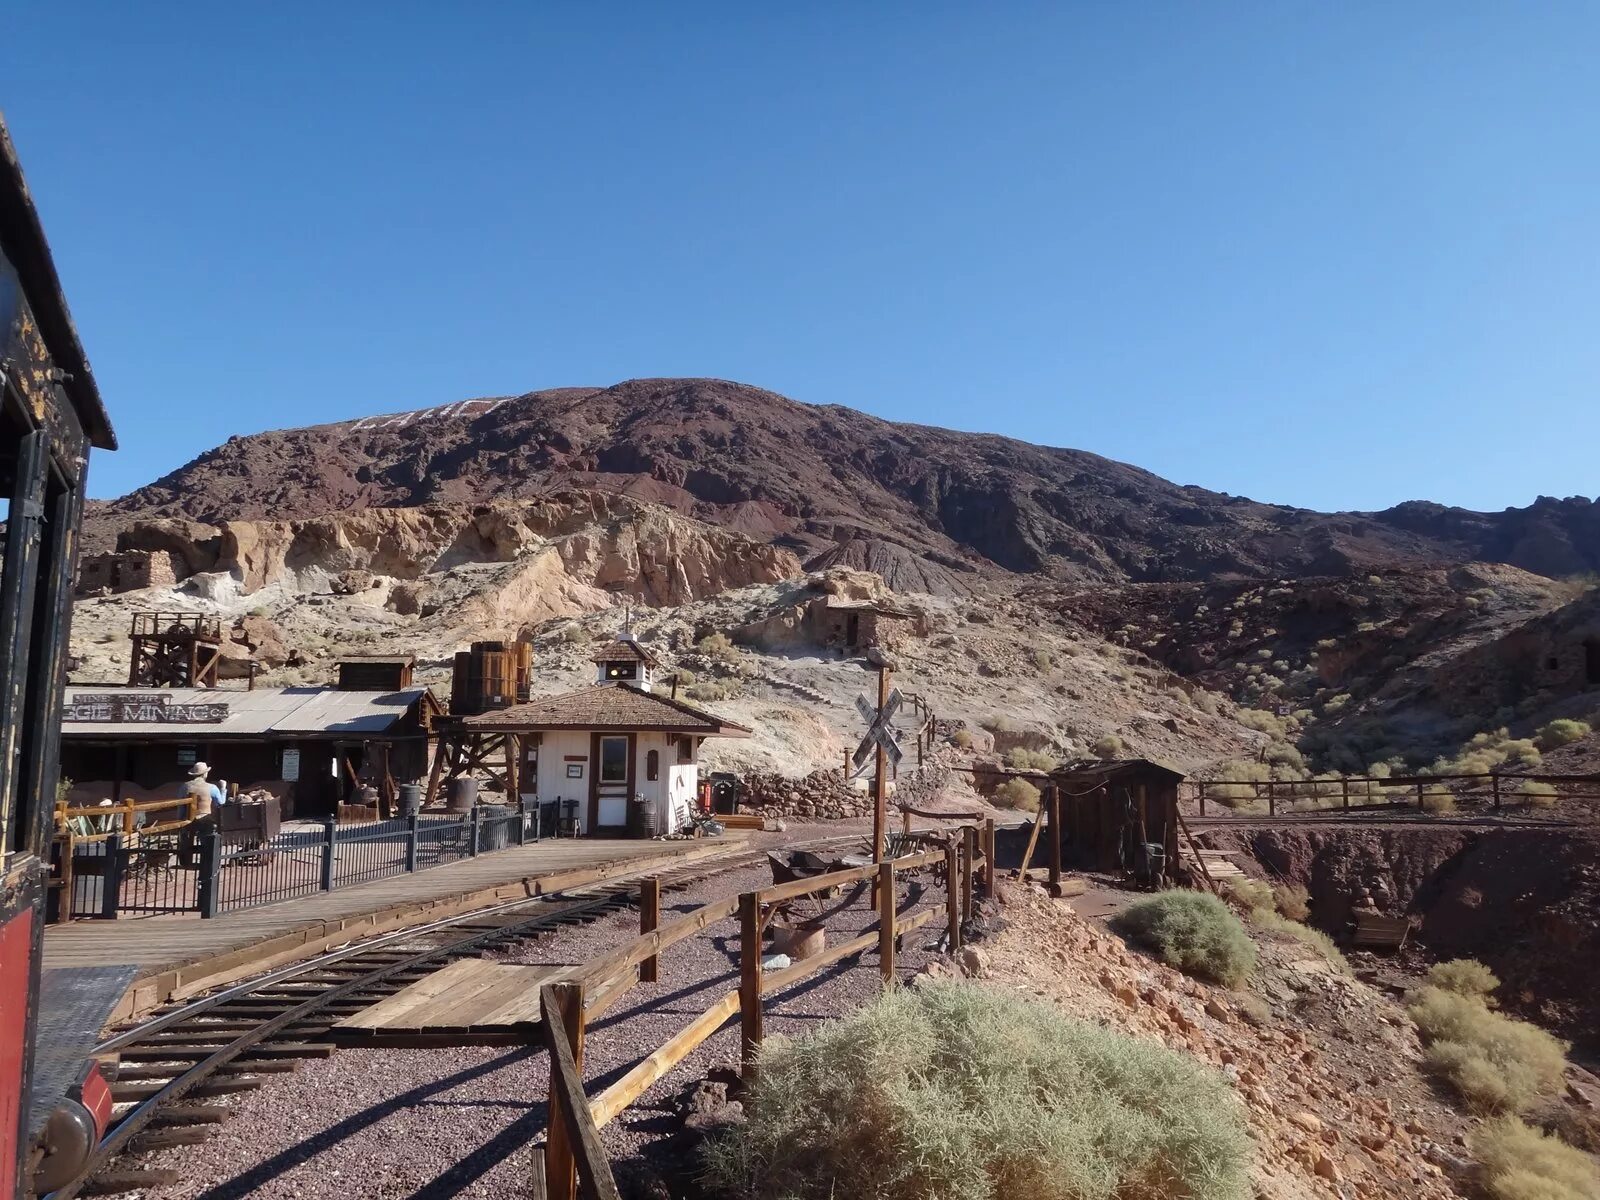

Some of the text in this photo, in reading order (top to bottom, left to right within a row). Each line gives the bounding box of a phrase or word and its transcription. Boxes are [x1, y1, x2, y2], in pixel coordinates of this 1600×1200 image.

[75, 694, 160, 703] MINE TOUR
[123, 704, 208, 721] MINING
